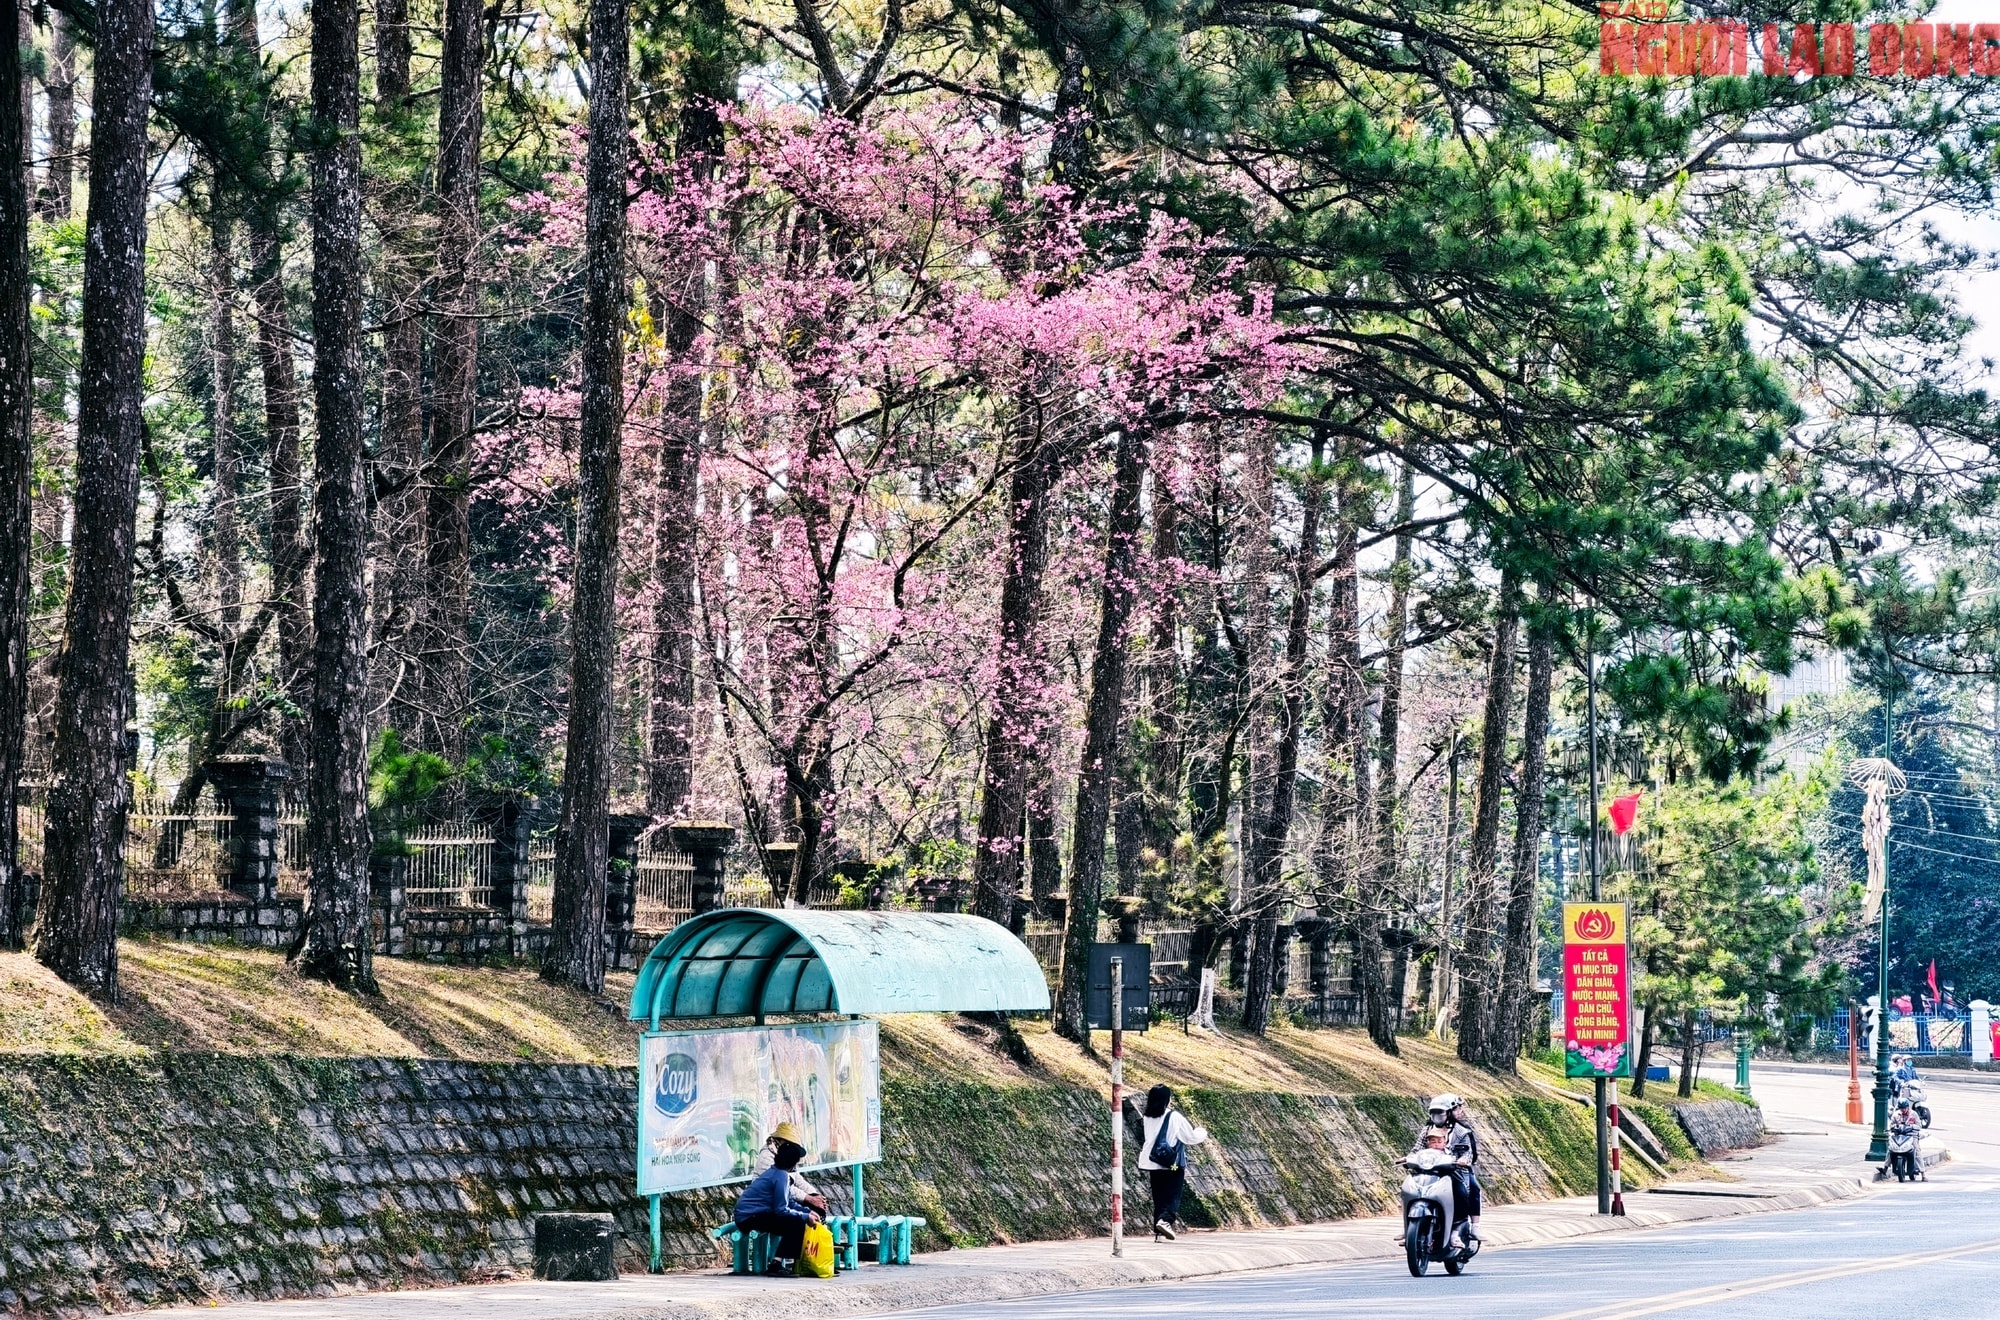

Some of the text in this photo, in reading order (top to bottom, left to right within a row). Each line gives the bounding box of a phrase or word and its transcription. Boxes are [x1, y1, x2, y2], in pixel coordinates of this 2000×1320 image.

[1582, 948, 1608, 961] TẤT CẢ
[1573, 963, 1618, 976] VÌ MỤC TIÊU
[1577, 976, 1615, 988] DÂN GIÀU,
[1572, 989, 1593, 1000] NƯỚC
[1579, 1000, 1614, 1014] DÂN CHỦ,
[1574, 1015, 1595, 1026] CÔNG
[1576, 1028, 1617, 1039] VĂN MINH!
[660, 1063, 694, 1103] Cozy
